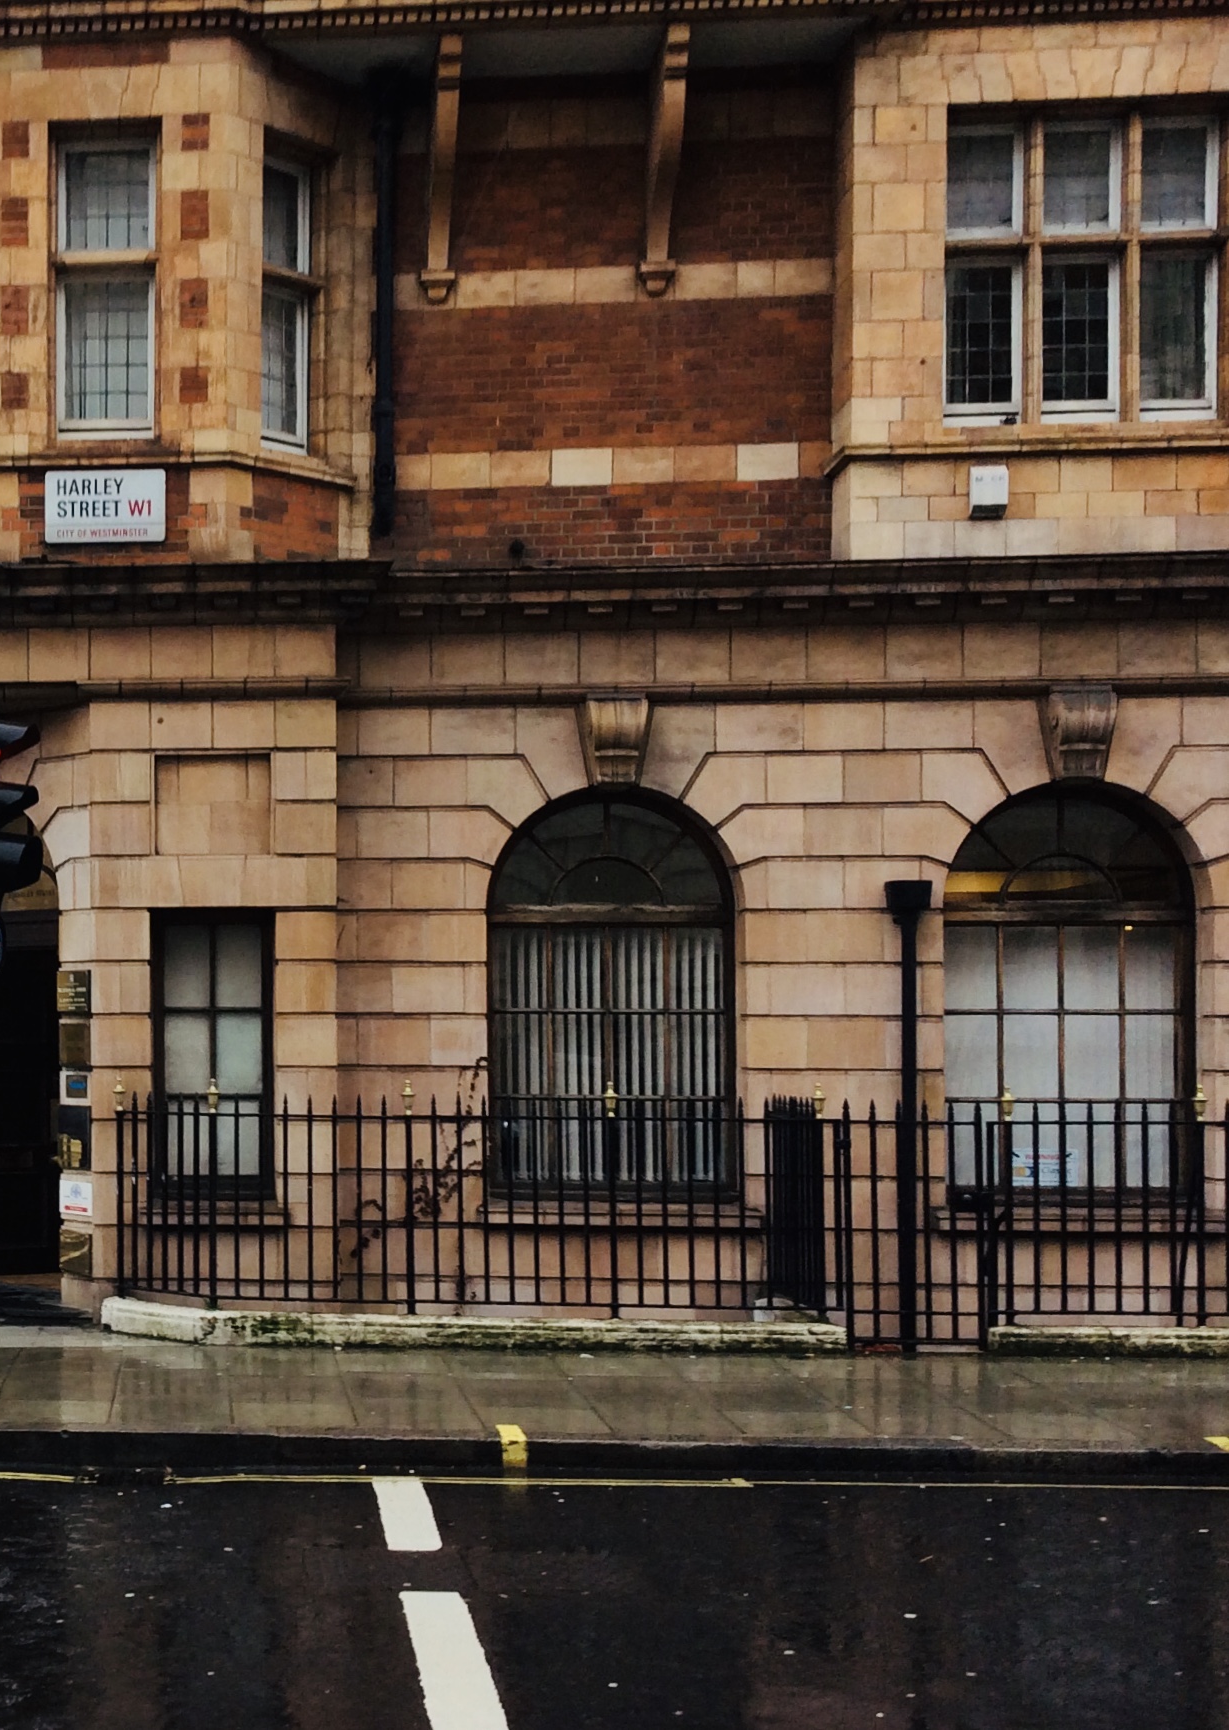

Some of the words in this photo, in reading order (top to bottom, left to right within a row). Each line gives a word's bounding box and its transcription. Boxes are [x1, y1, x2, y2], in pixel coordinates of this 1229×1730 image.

[57, 477, 124, 496] HARLEY
[57, 500, 121, 518] STREET
[128, 499, 152, 517] W1
[57, 530, 75, 538] CITY
[90, 528, 148, 537] WESTMINSTER
